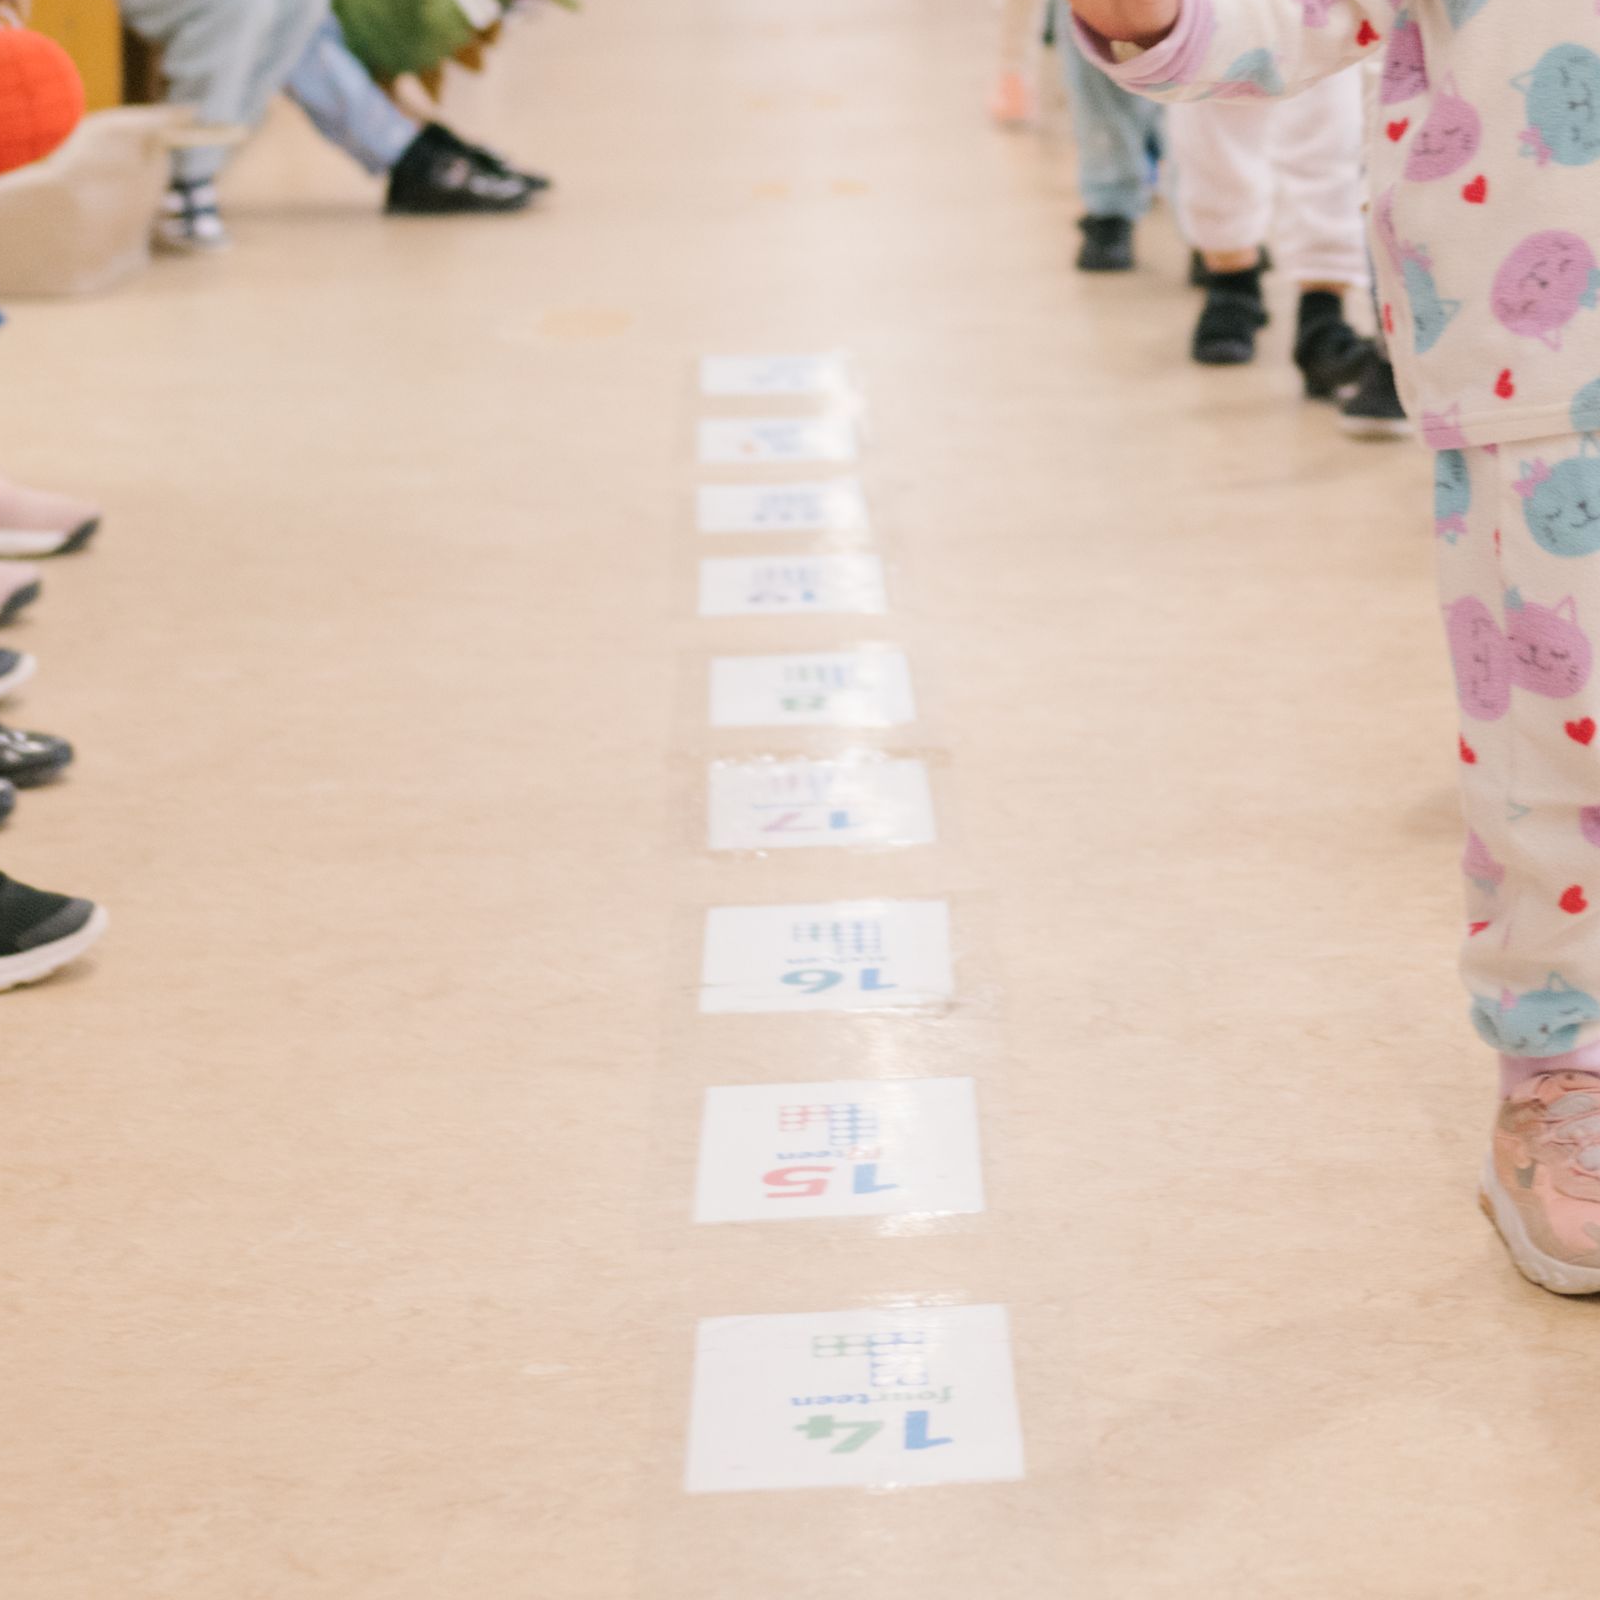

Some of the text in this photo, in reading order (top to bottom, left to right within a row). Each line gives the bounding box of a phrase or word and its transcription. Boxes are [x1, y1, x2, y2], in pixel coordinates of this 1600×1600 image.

[780, 968, 898, 994] 16
[762, 1164, 899, 1198] 15
[793, 1411, 953, 1453] 14
